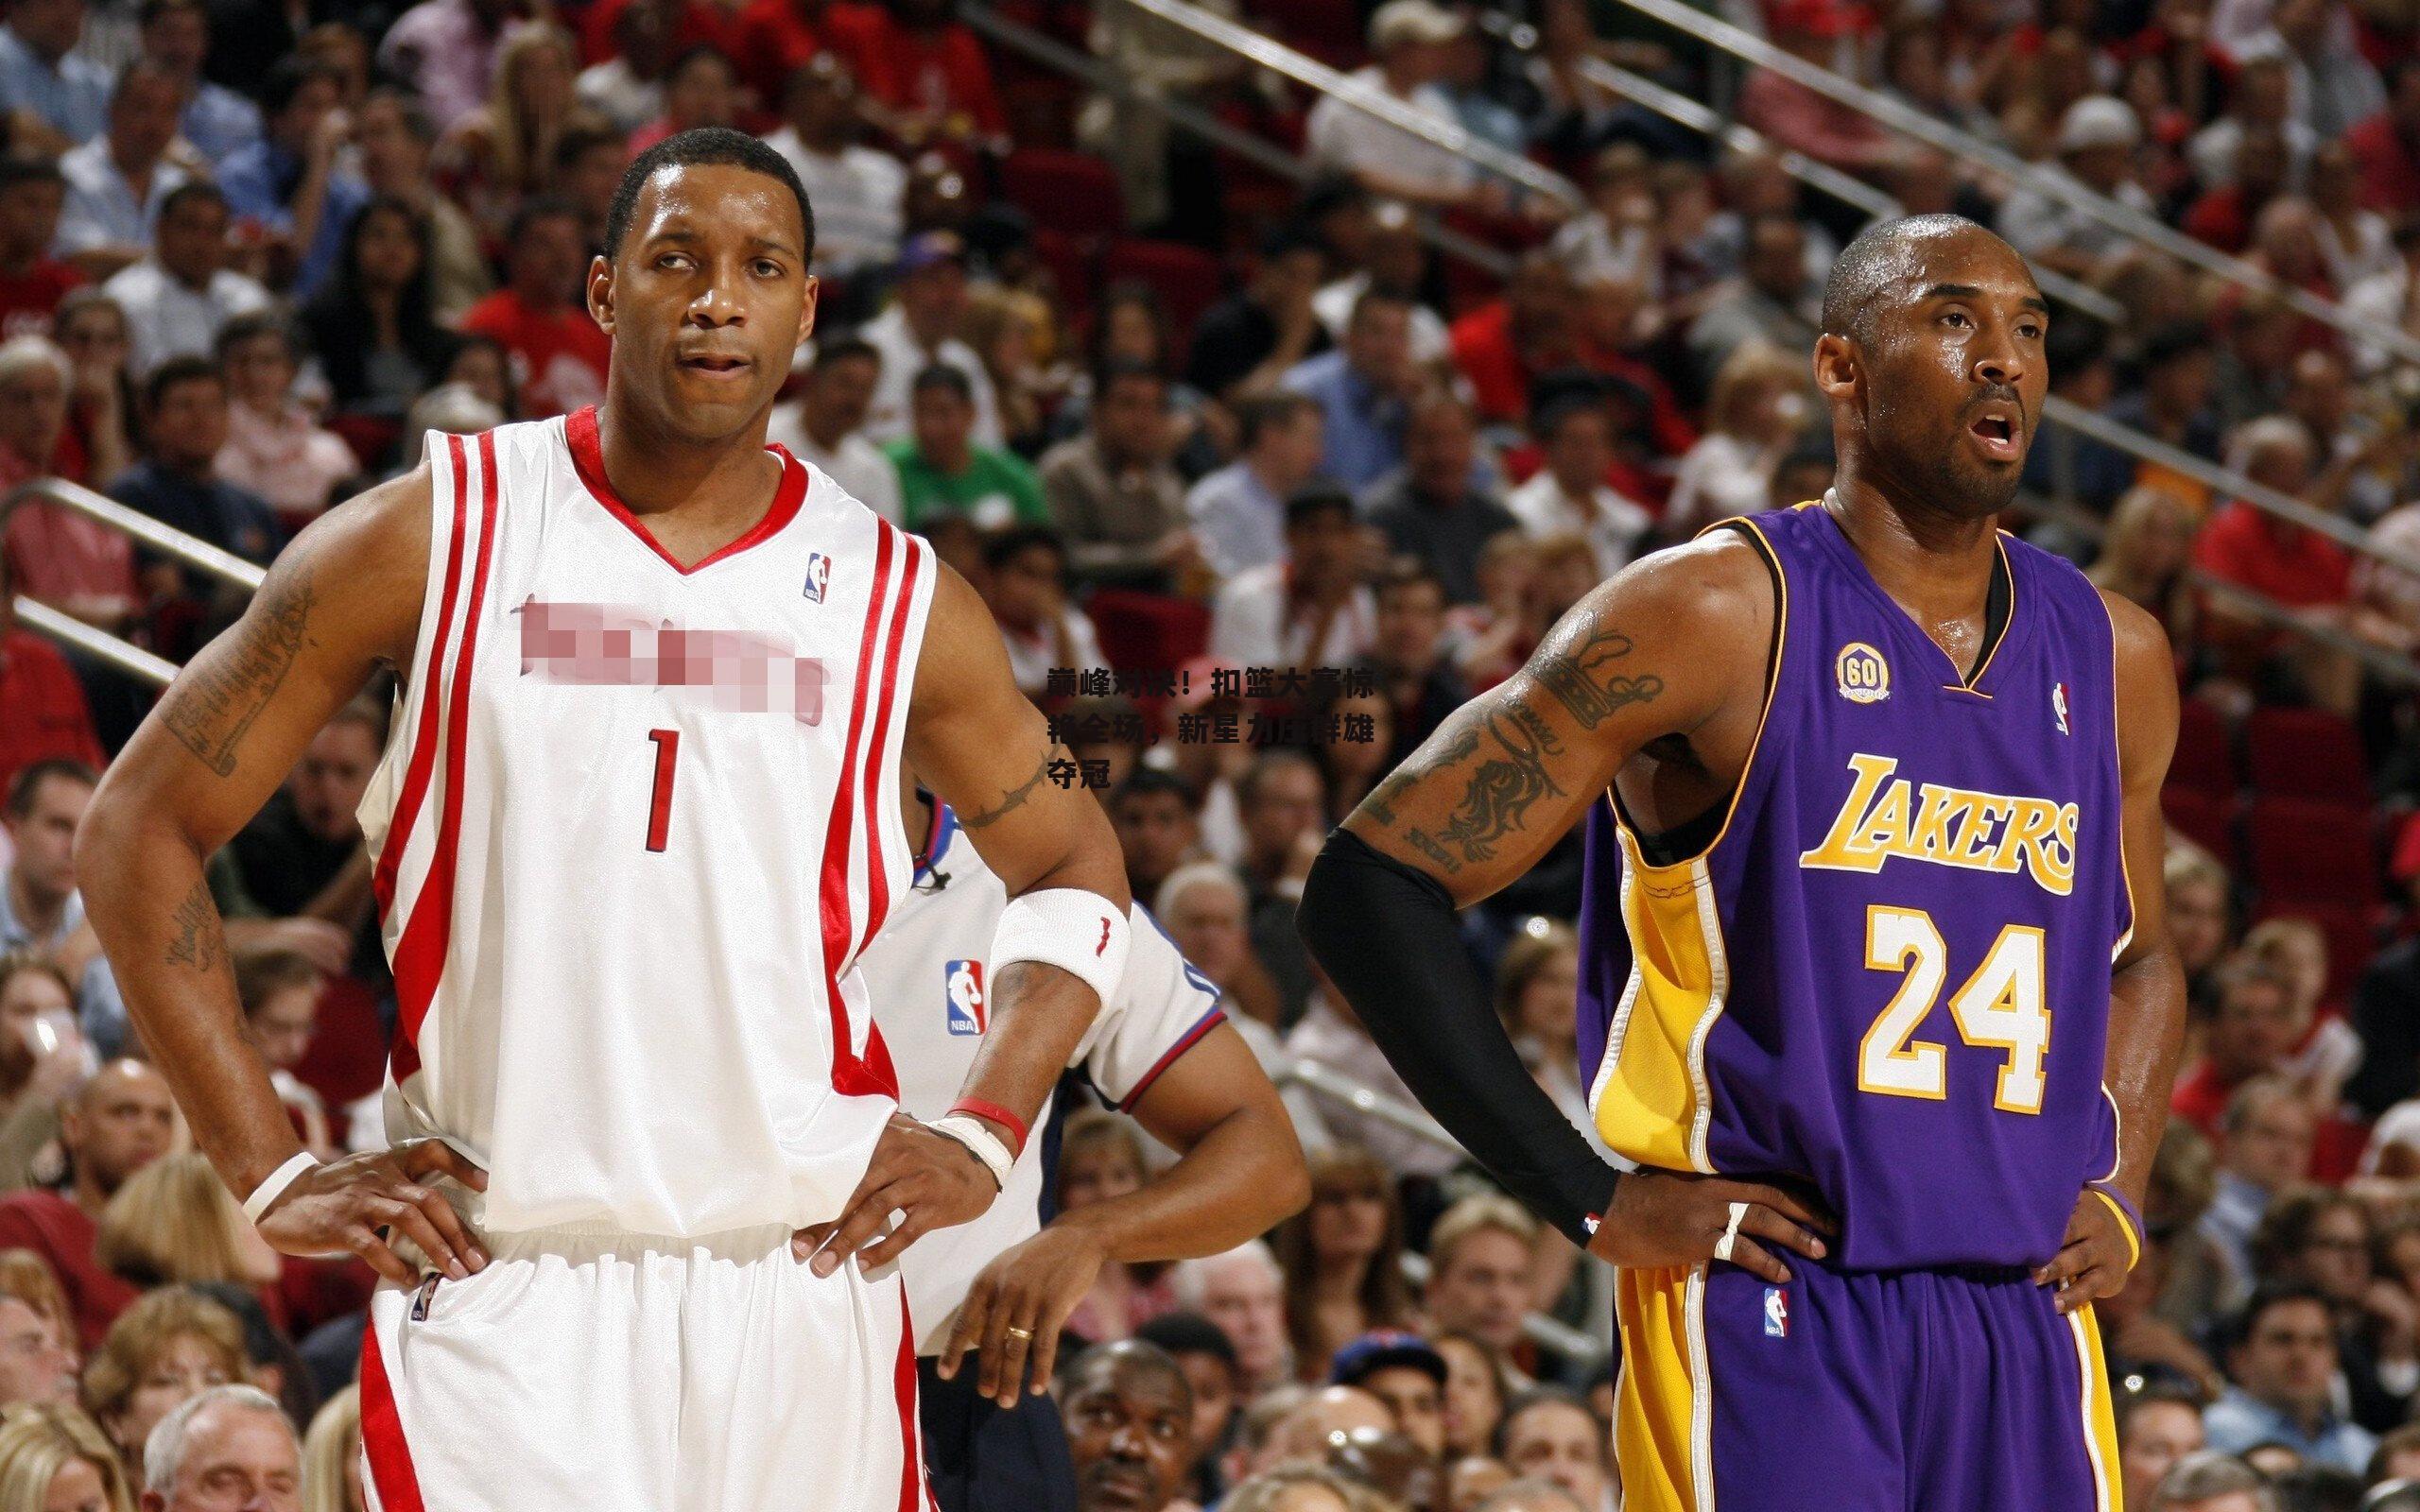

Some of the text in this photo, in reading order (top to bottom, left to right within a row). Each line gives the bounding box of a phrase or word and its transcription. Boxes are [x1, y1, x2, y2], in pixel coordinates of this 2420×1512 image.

[1846, 657, 1877, 687] 60
[646, 729, 680, 852] 1
[1799, 752, 2079, 896] LAKERS
[950, 1020, 974, 1032] NBA
[1858, 904, 2052, 1115] 24
